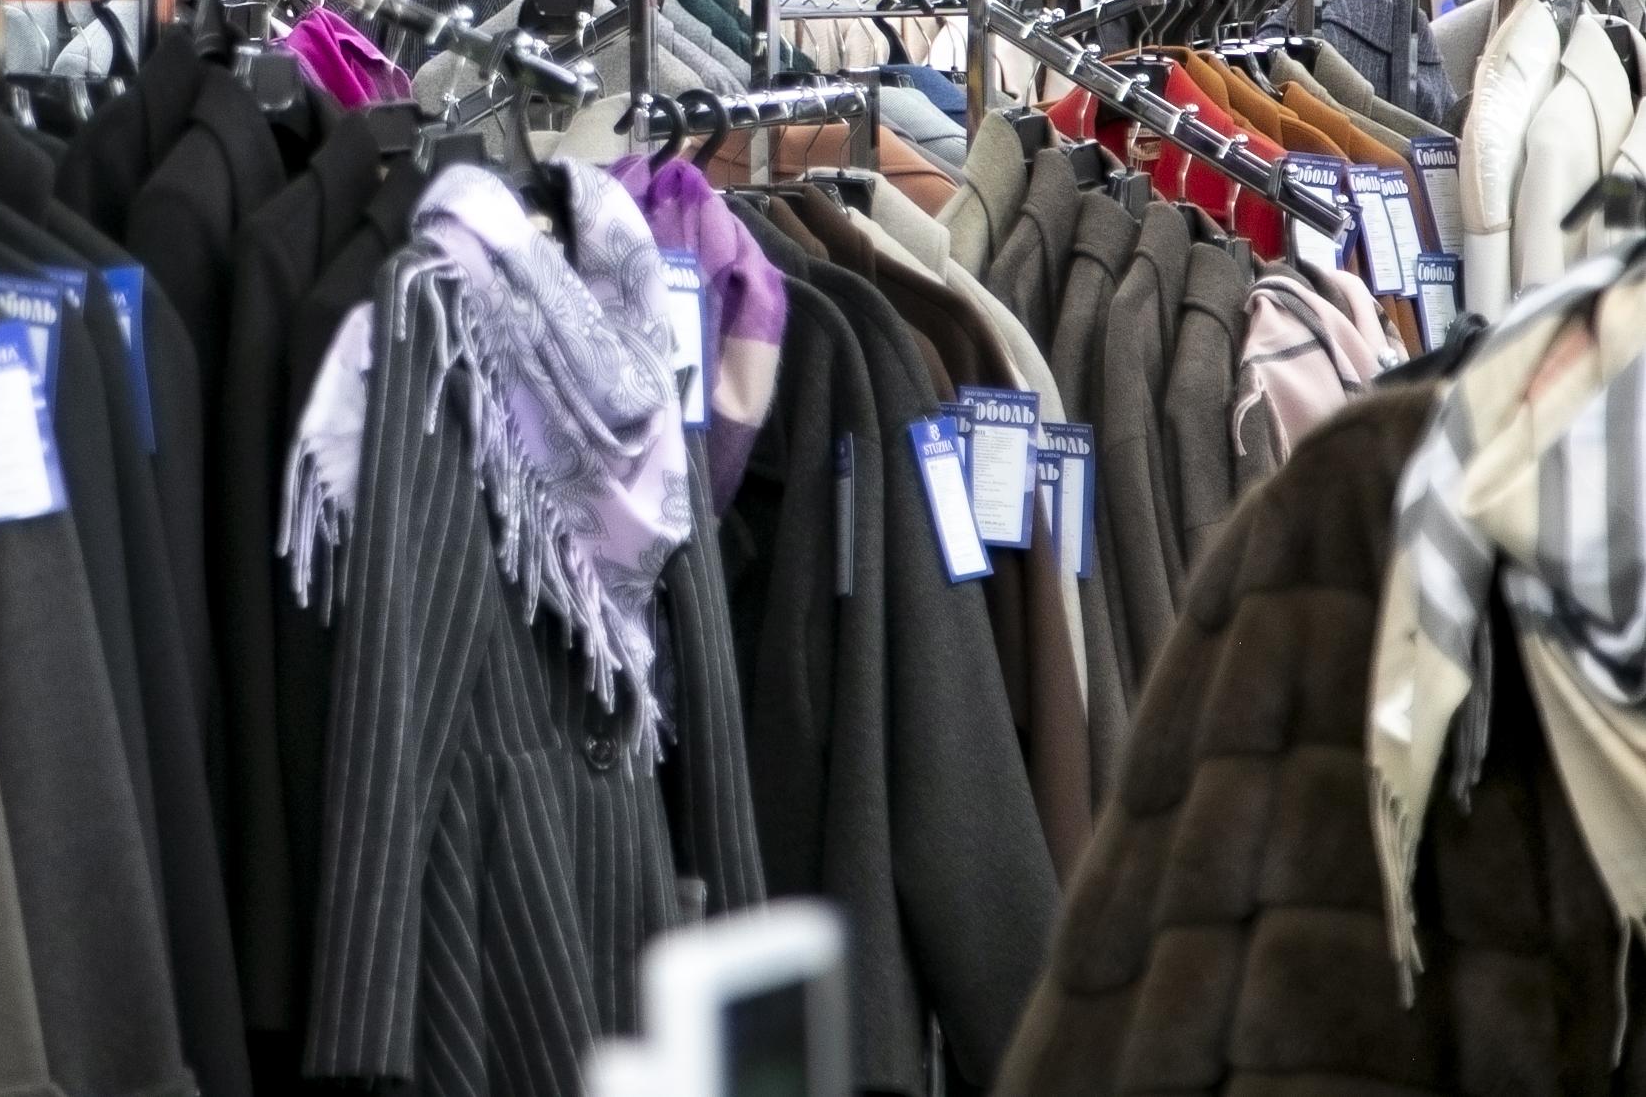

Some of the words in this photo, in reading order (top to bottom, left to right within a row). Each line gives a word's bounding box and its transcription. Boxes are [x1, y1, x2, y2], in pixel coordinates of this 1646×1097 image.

[1416, 148, 1456, 166] Соболь
[1297, 165, 1337, 185] оболь
[1380, 179, 1408, 196] боль
[1418, 263, 1454, 282] Соболь
